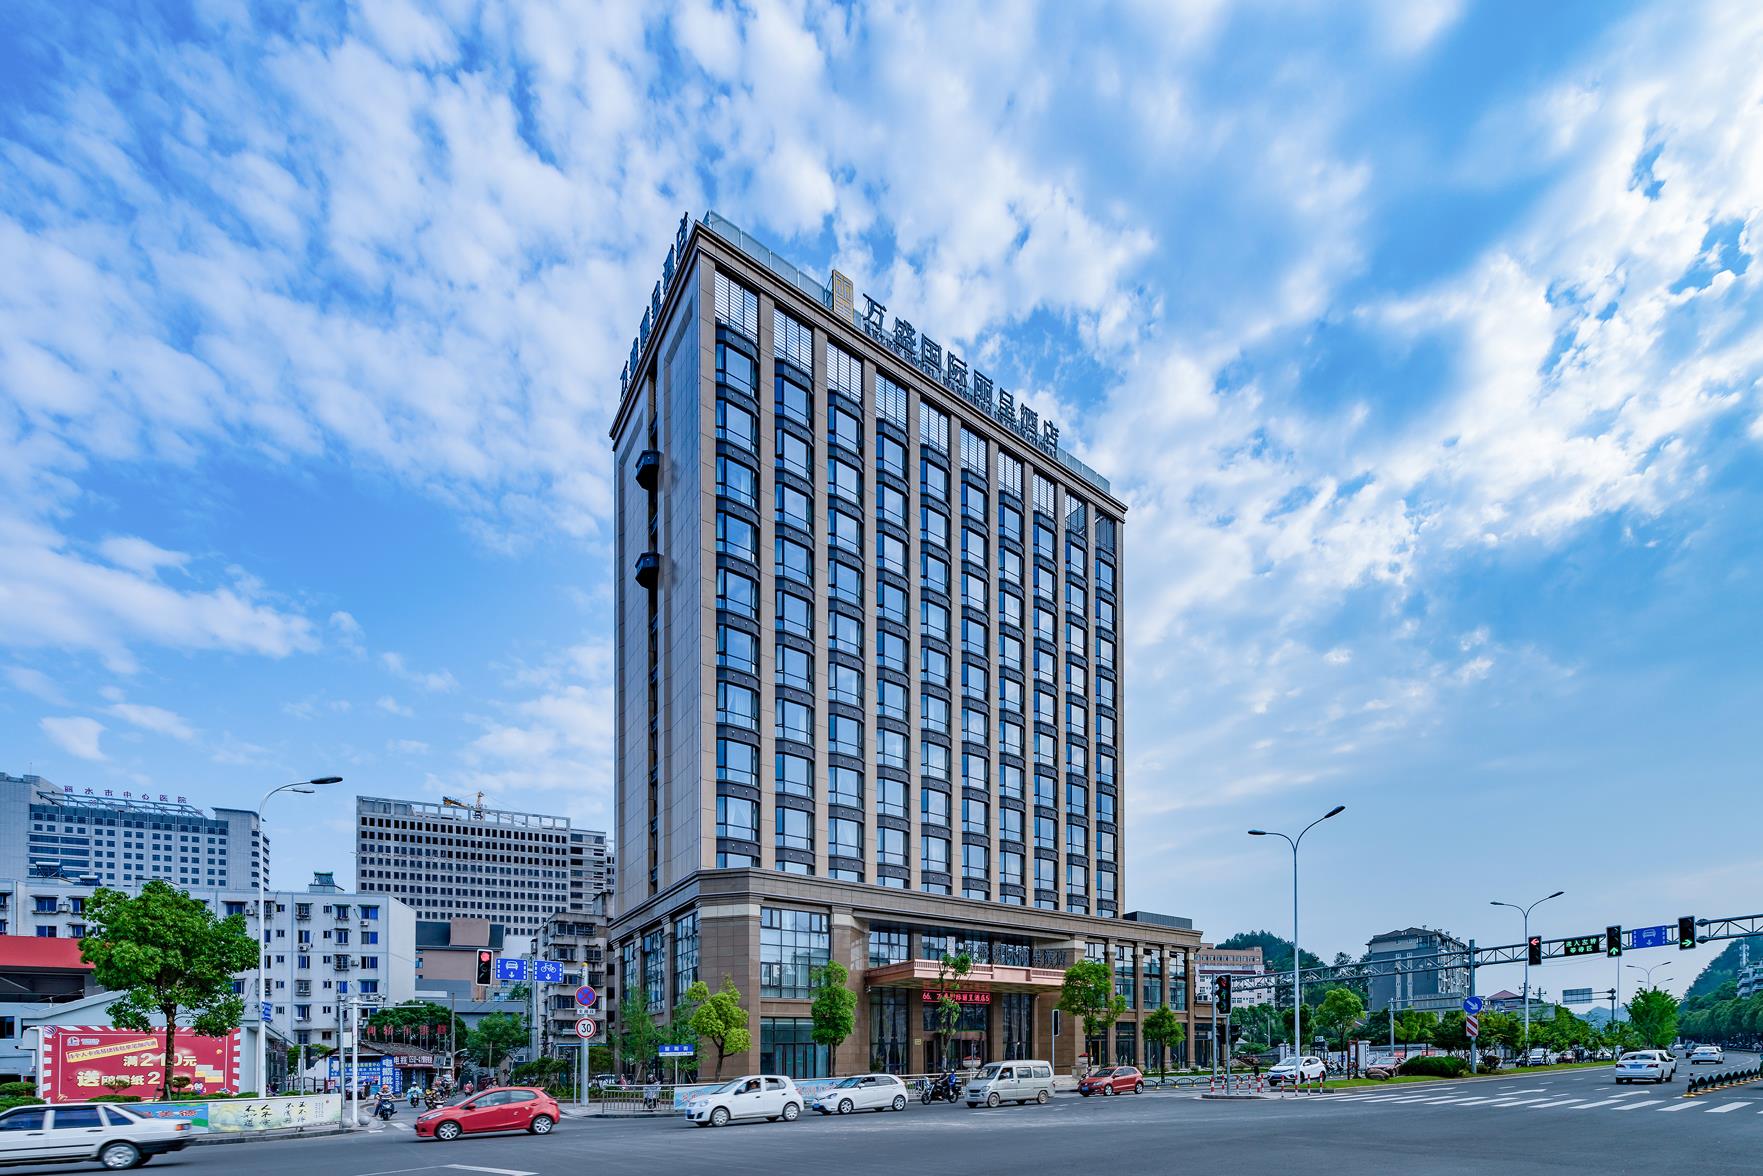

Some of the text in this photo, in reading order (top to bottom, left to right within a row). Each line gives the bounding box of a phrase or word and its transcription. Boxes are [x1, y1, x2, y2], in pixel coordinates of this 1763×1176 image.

[862, 293, 1060, 449] 万盛国际丽呈酒店
[64, 785, 187, 804] 丽水市中心医院
[581, 1023, 592, 1033] 30
